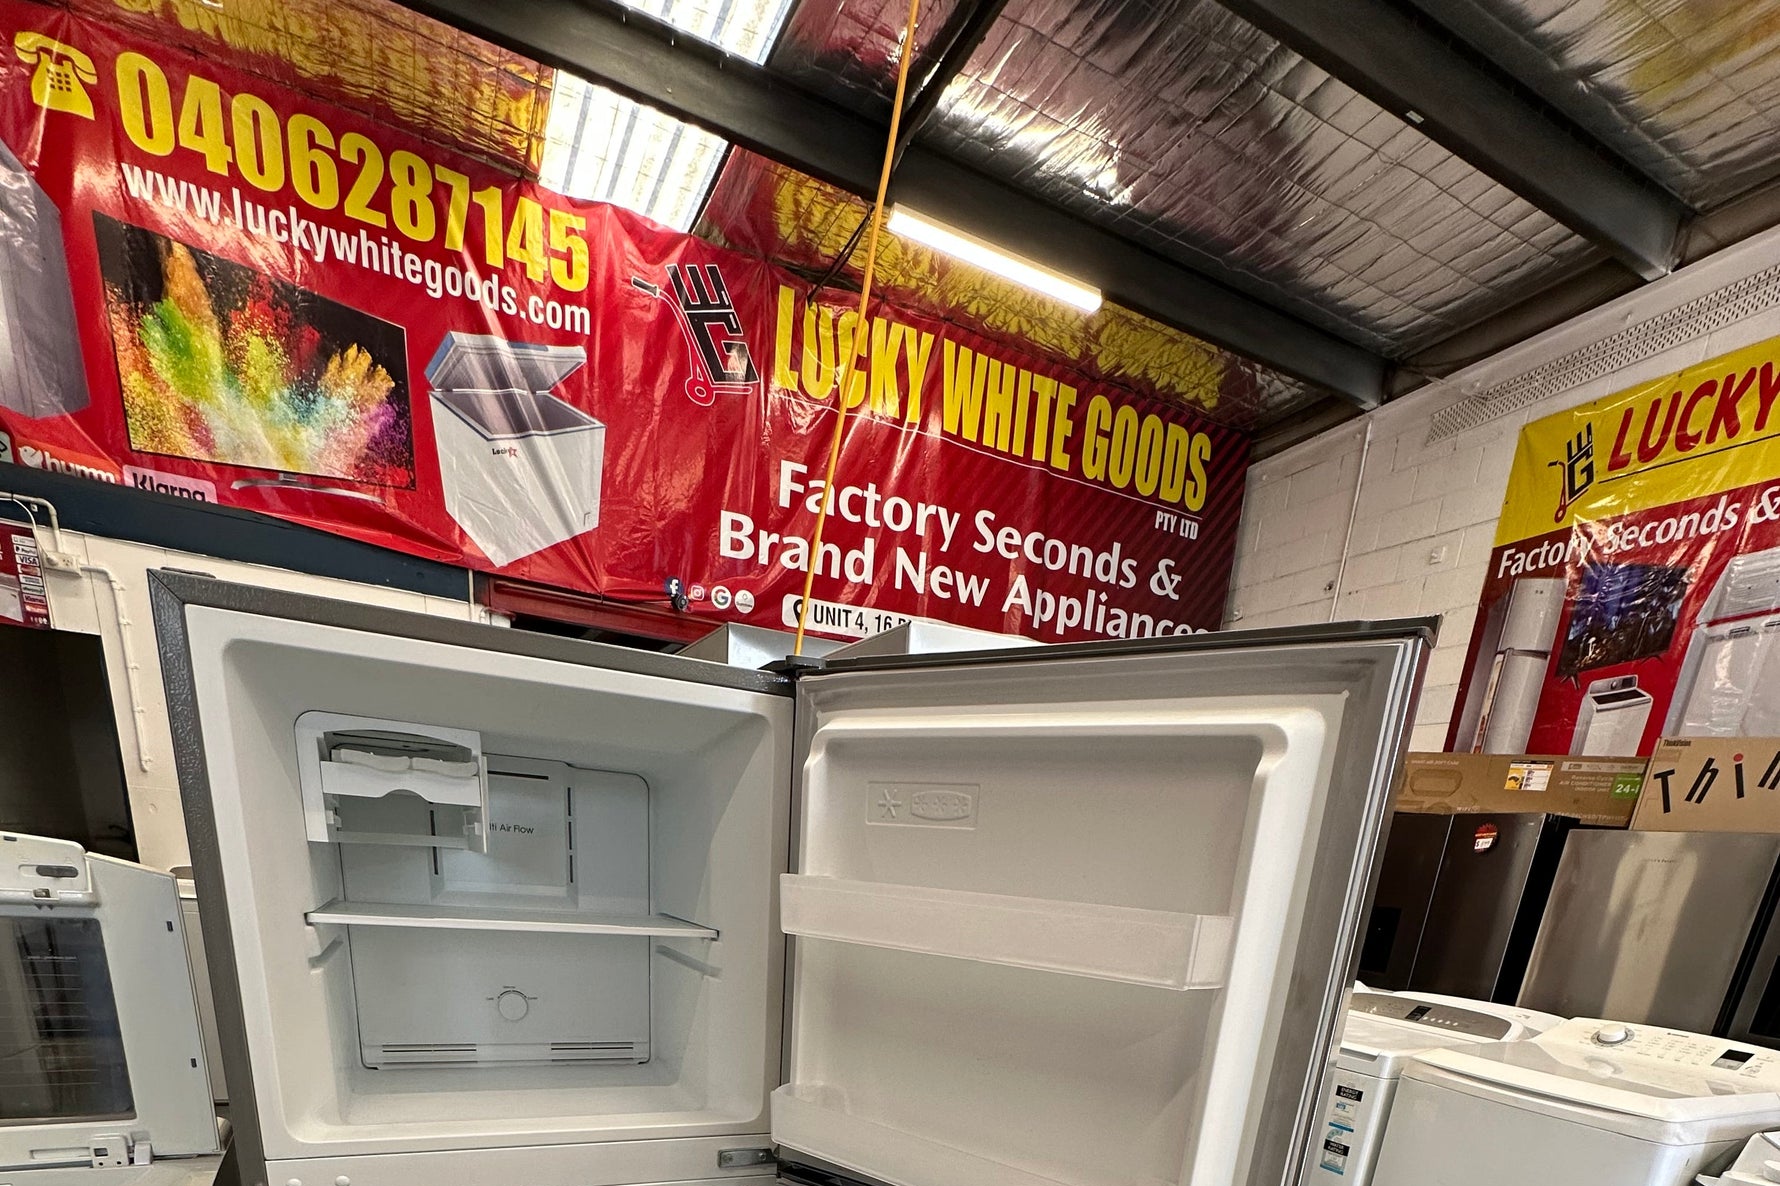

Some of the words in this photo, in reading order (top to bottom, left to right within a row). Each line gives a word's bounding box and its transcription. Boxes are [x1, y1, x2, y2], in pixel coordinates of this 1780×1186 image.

[115, 51, 590, 293] 0406287145
[121, 162, 590, 335] www.luckywhitegoods.com
[773, 284, 935, 424] LUCKY
[943, 338, 1077, 472] WHITE
[1082, 395, 1211, 512] GOODS
[1607, 361, 1780, 472] LUCKY
[719, 509, 874, 585] Brand
[895, 551, 990, 601] New
[1001, 574, 1209, 639] Applianc
[778, 460, 961, 552] Factory
[973, 509, 1138, 589] Seconds
[1150, 558, 1182, 600] &
[1154, 510, 1177, 534] PTY
[1179, 517, 1199, 541] LTD
[1498, 536, 1592, 579] Factory
[1604, 495, 1741, 554] Seconds
[1752, 485, 1780, 524] &
[814, 604, 852, 628] UNIT
[855, 612, 868, 634] 4,
[875, 614, 893, 633] 16
[500, 823, 512, 832] Air
